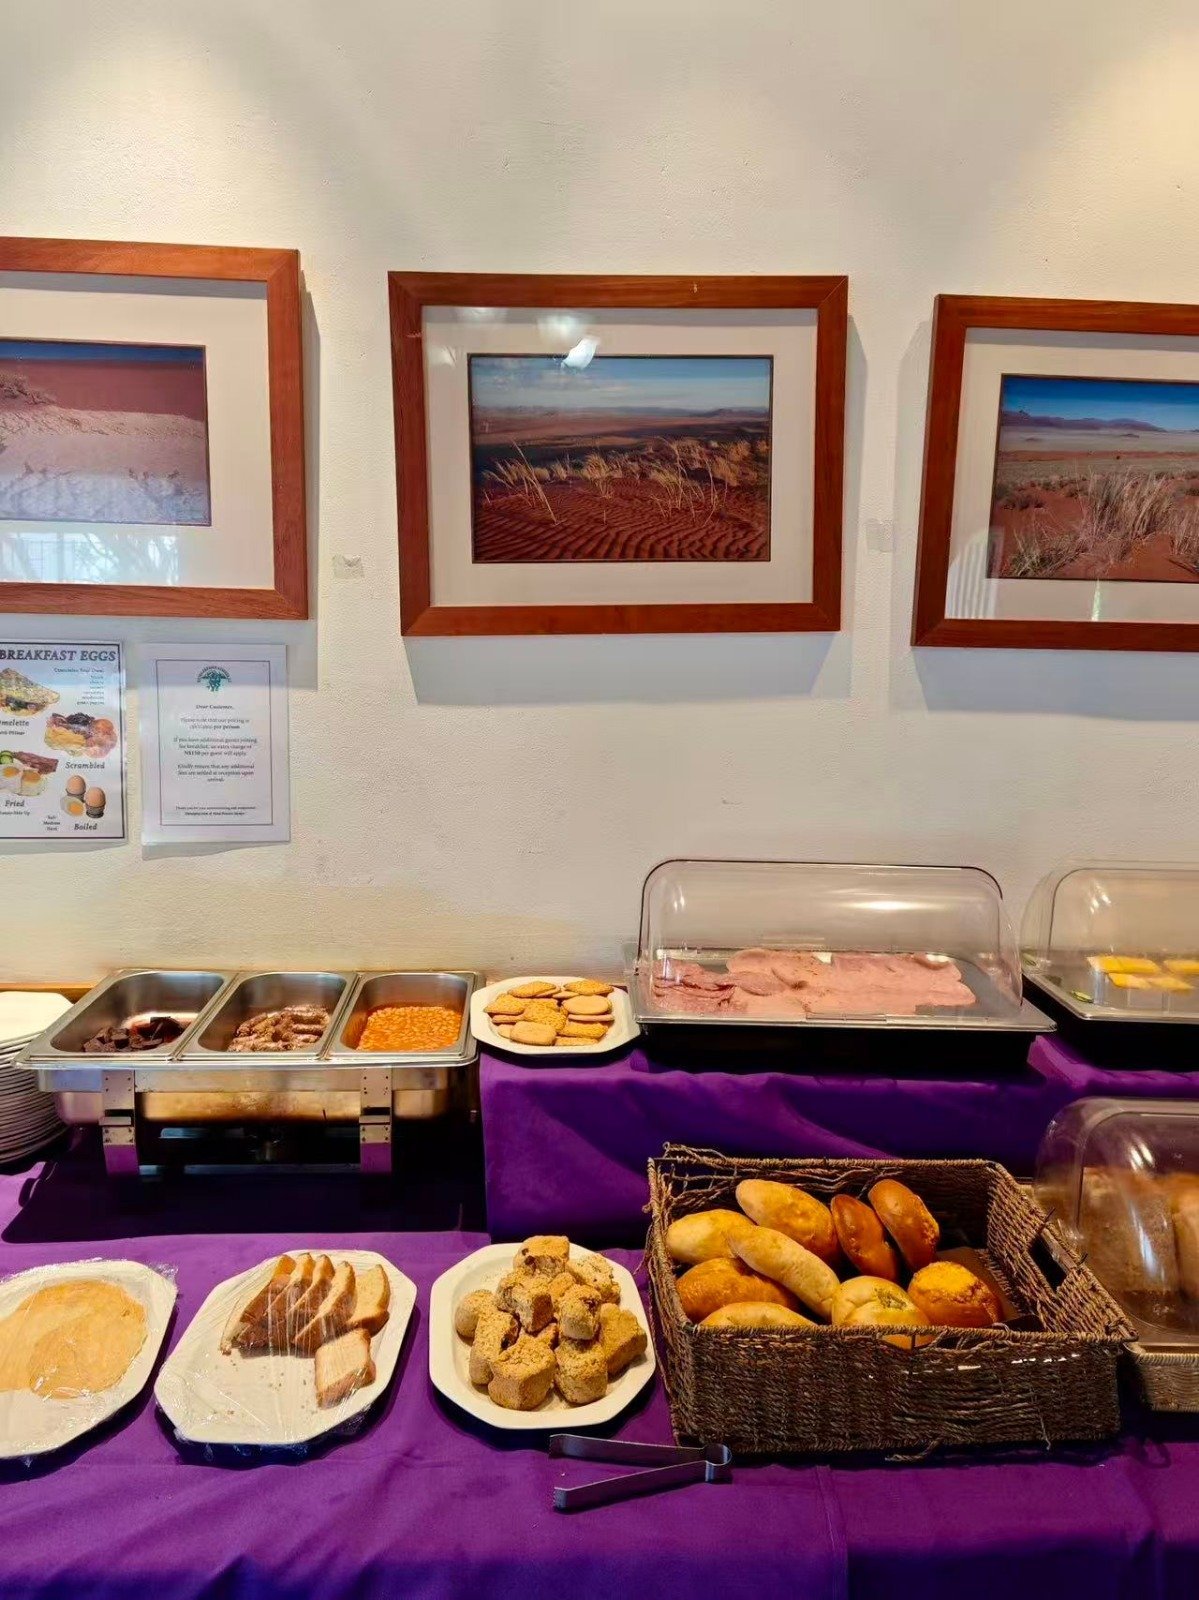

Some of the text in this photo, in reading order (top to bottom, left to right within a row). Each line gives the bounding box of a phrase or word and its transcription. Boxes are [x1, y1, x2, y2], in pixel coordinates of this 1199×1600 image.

[0, 649, 116, 661] BREAKFAST EGGS
[0, 719, 29, 727] melette
[65, 761, 105, 769] Scrambled
[73, 822, 98, 831] Boiled
